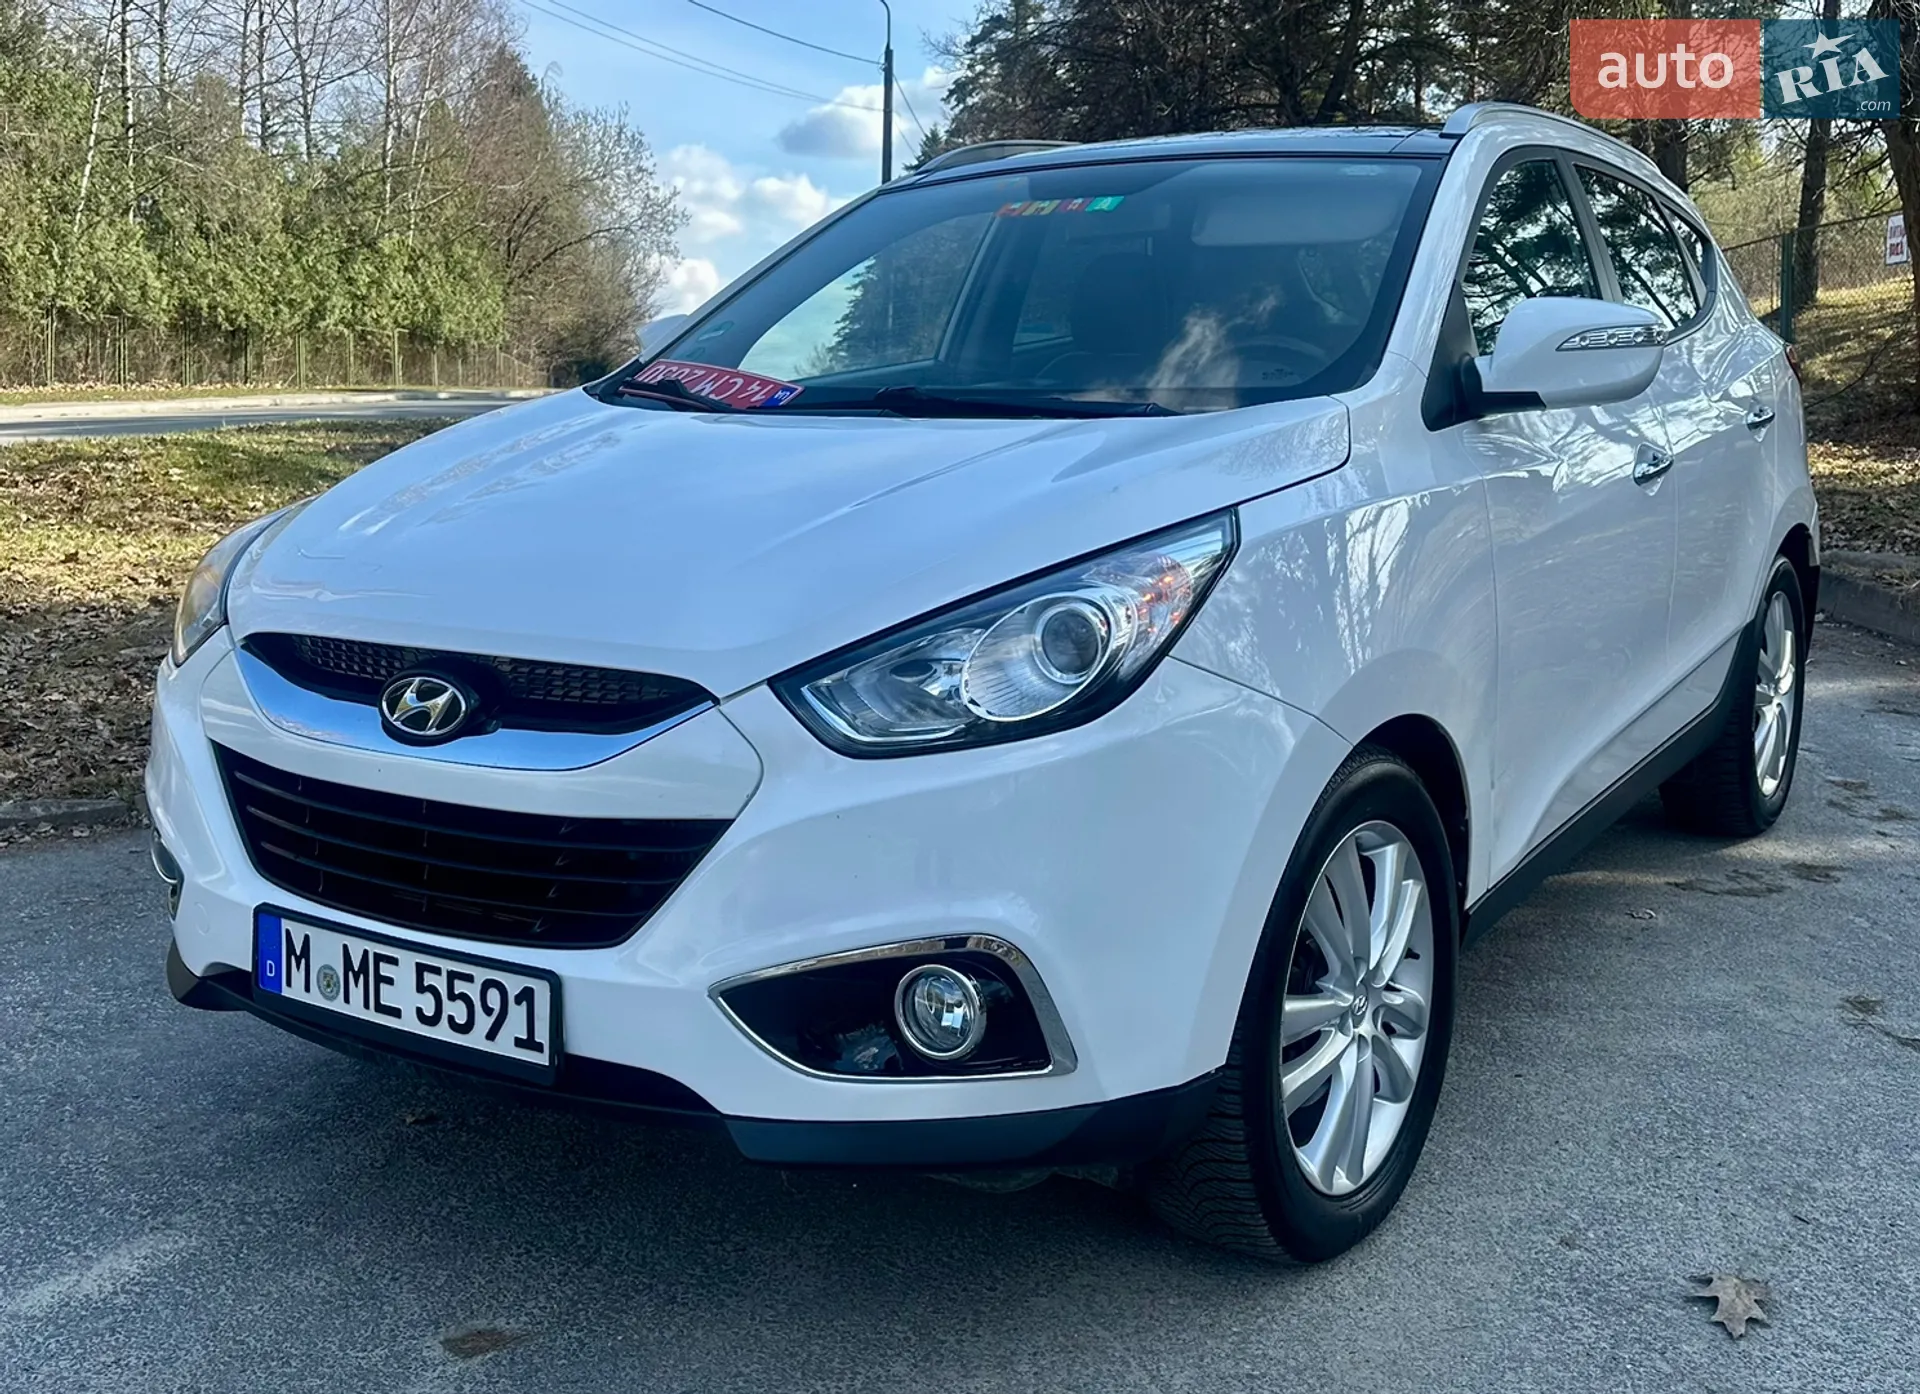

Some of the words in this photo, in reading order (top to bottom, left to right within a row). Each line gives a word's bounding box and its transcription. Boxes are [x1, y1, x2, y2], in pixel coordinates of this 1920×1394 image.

[690, 373, 744, 401] CM
[737, 381, 774, 402] 14
[775, 389, 790, 400] UA
[266, 960, 275, 977] D
[285, 927, 311, 994] M
[342, 943, 402, 1019] ME
[415, 960, 545, 1053] 5591
